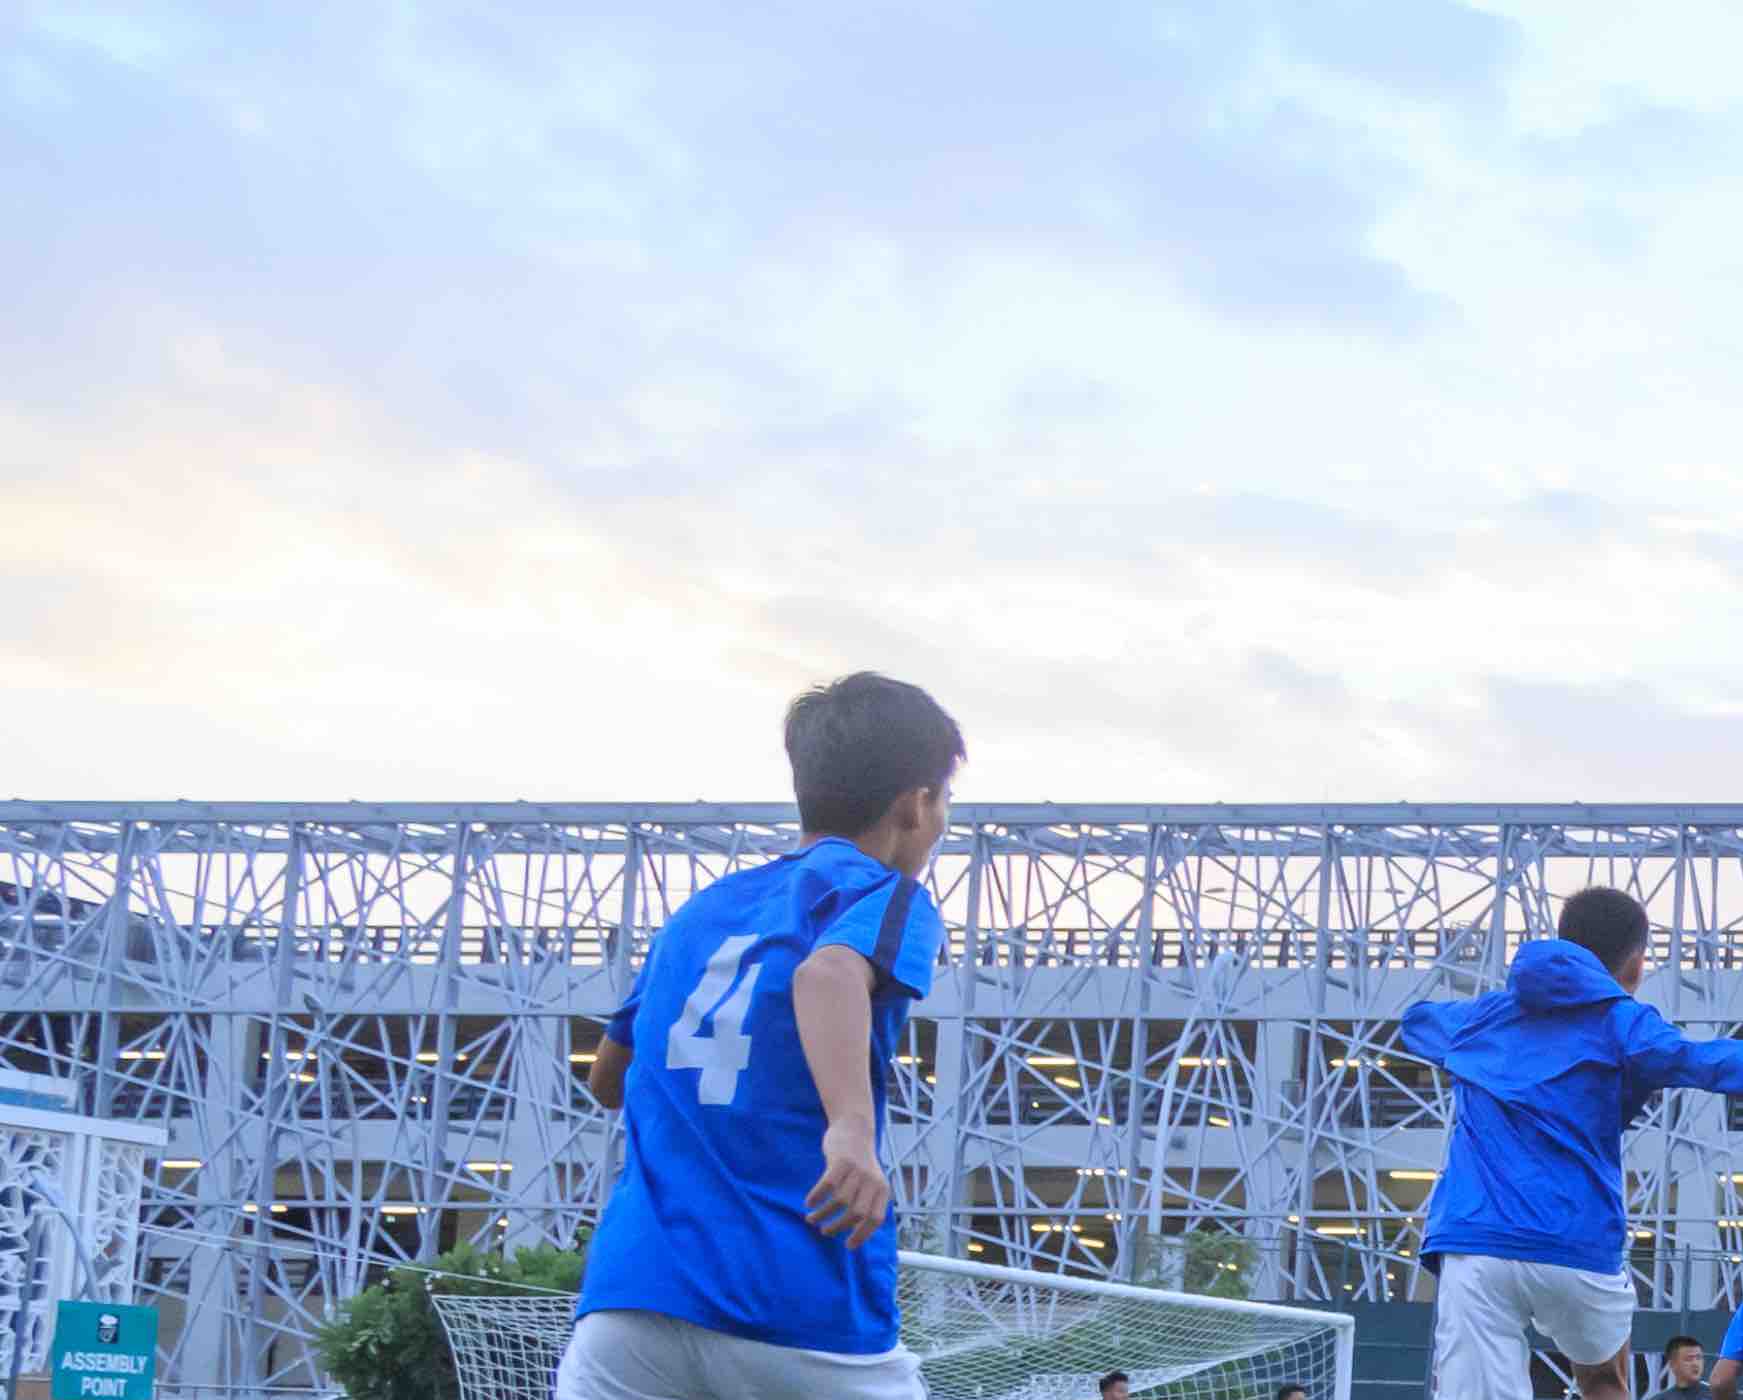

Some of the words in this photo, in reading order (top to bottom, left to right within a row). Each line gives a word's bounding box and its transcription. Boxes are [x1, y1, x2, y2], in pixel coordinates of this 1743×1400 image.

[666, 934, 761, 1105] 4
[61, 1351, 148, 1376] ASSEMBLY
[80, 1376, 127, 1397] POINT
